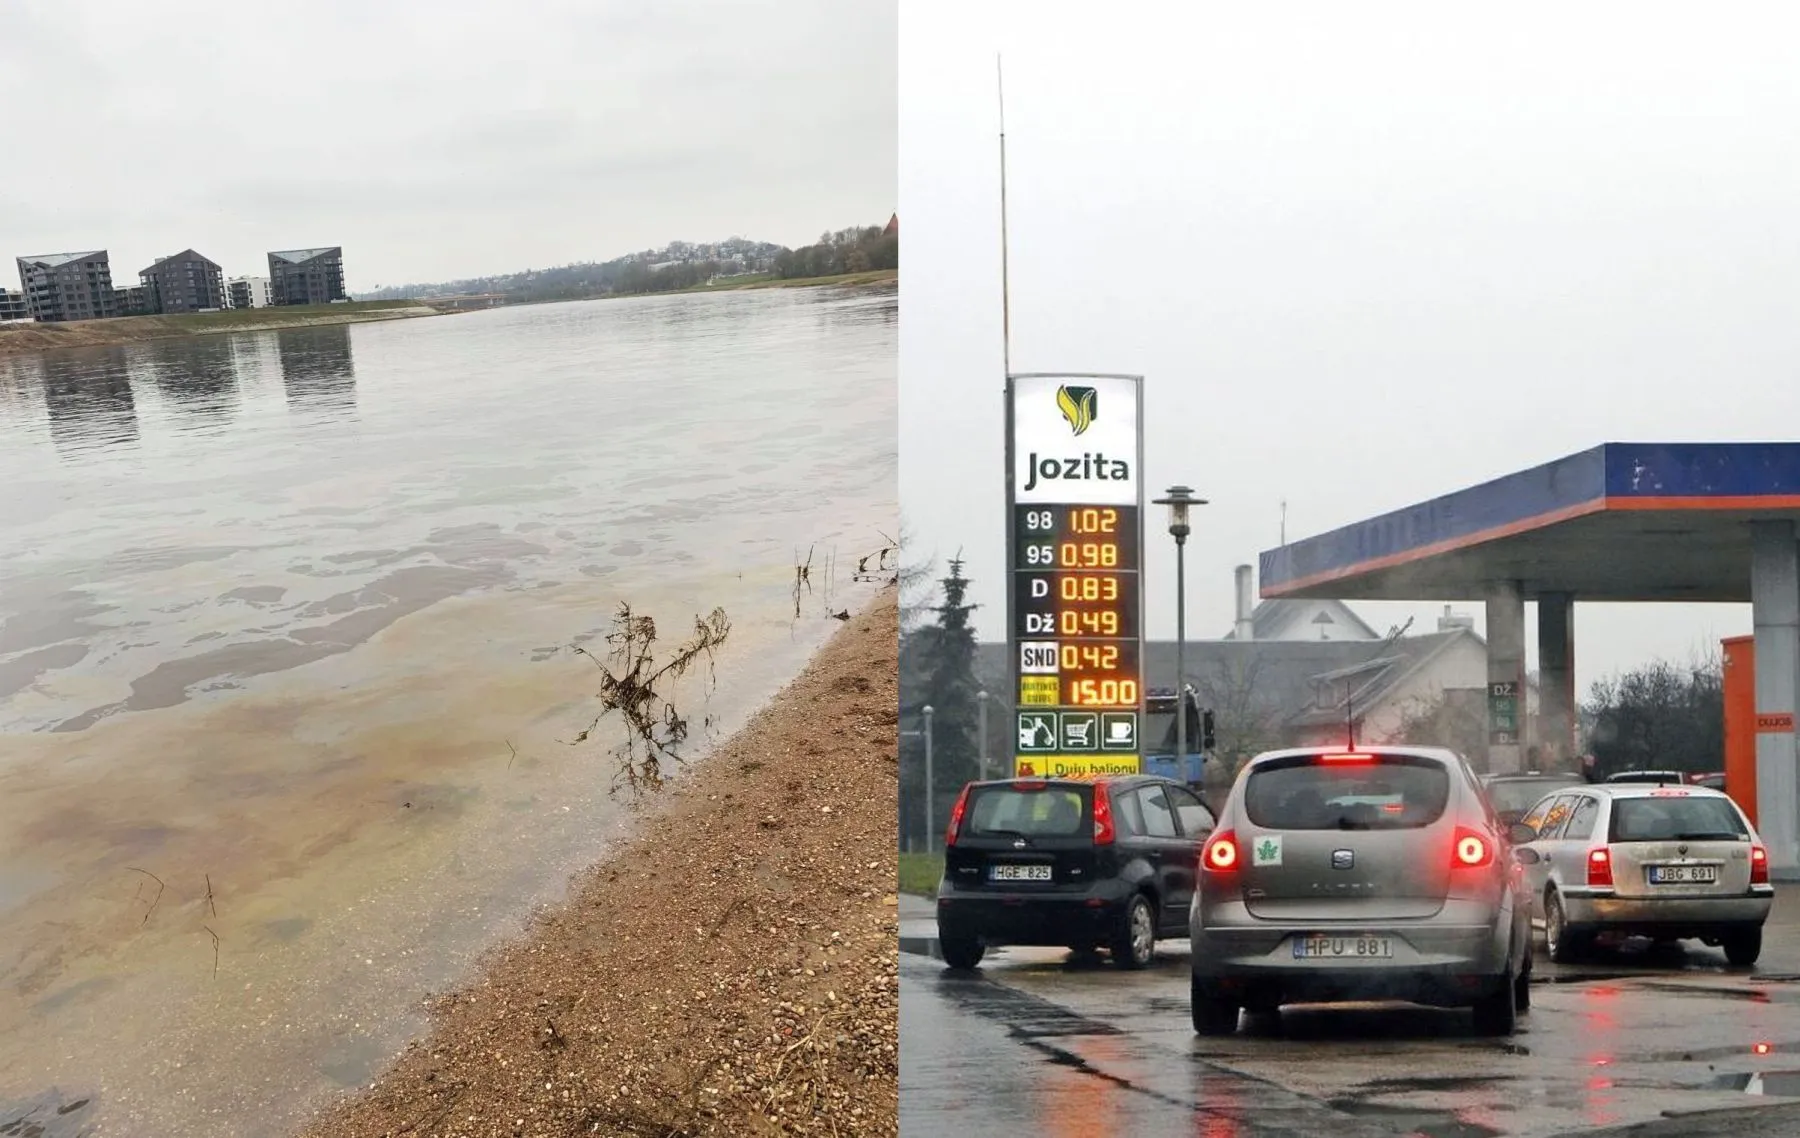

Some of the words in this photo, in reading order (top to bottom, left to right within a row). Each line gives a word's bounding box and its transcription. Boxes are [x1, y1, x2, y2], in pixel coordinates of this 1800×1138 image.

[1024, 452, 1129, 491] Jozita
[1026, 511, 1053, 530] 98
[1071, 509, 1117, 533] 1.02
[1026, 545, 1053, 564] 95
[1061, 543, 1117, 567] 0.98
[1031, 578, 1049, 598] D
[1061, 576, 1118, 600] 0.83
[1026, 613, 1055, 633] Dž
[1061, 610, 1118, 635] 0.49
[1023, 648, 1056, 667] SND
[1061, 645, 1118, 670] 0.42
[1071, 679, 1137, 705] 15.00
[997, 866, 1021, 879] HGE
[1028, 866, 1050, 879] 825
[1305, 939, 1344, 955] HPU
[1356, 939, 1389, 955] 881
